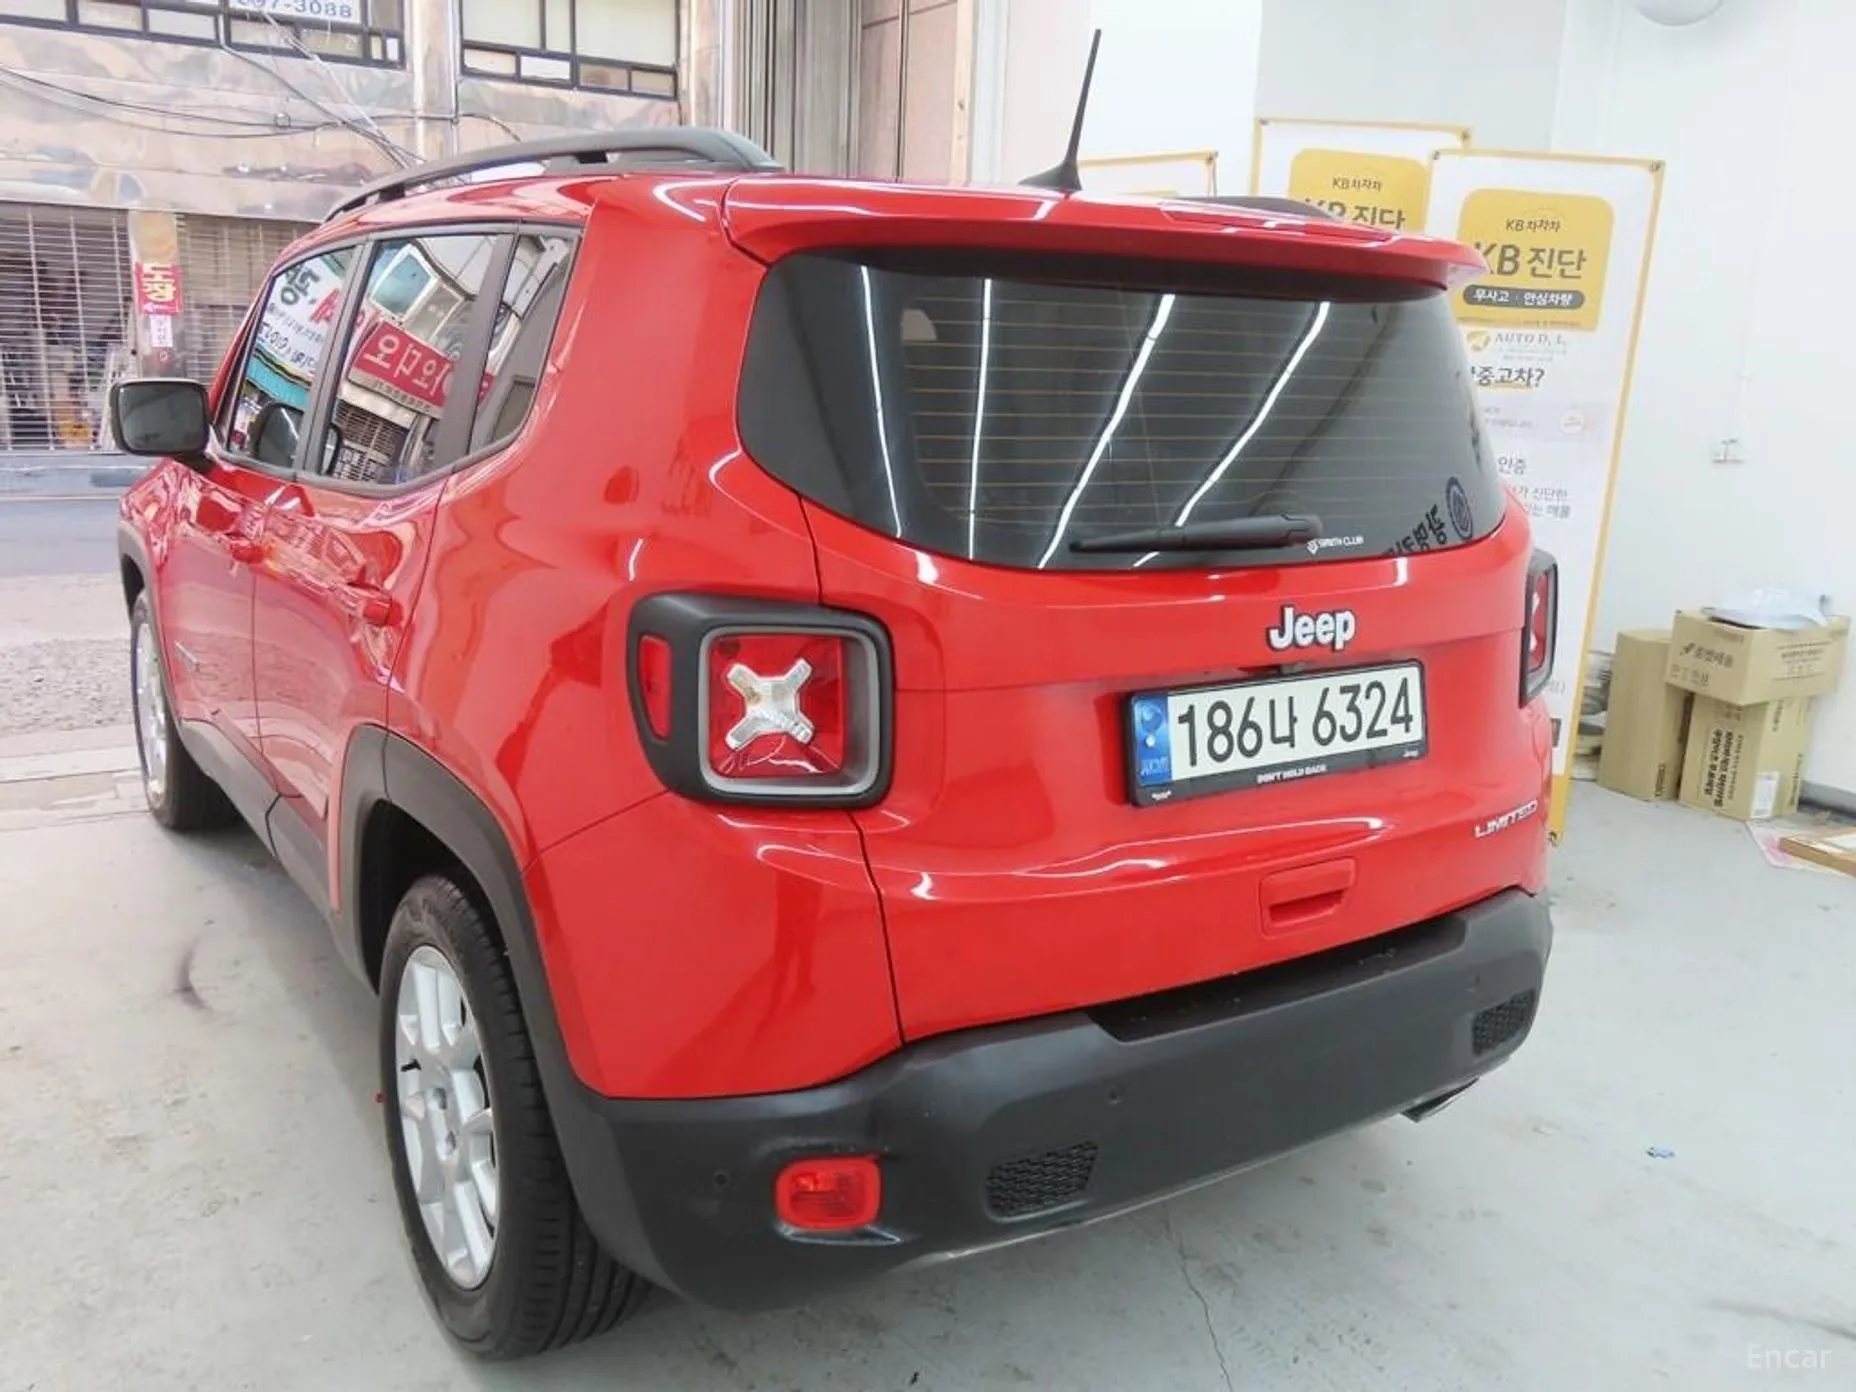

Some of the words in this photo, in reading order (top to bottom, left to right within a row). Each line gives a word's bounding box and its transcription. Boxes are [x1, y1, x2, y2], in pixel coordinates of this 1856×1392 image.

[1527, 247, 1587, 279] 진단
[1473, 288, 1510, 304] 무사고
[1267, 605, 1357, 651] Jeep
[1177, 695, 1298, 767] 186나
[1312, 677, 1414, 747] 6324
[1474, 799, 1539, 839] LIMITED
